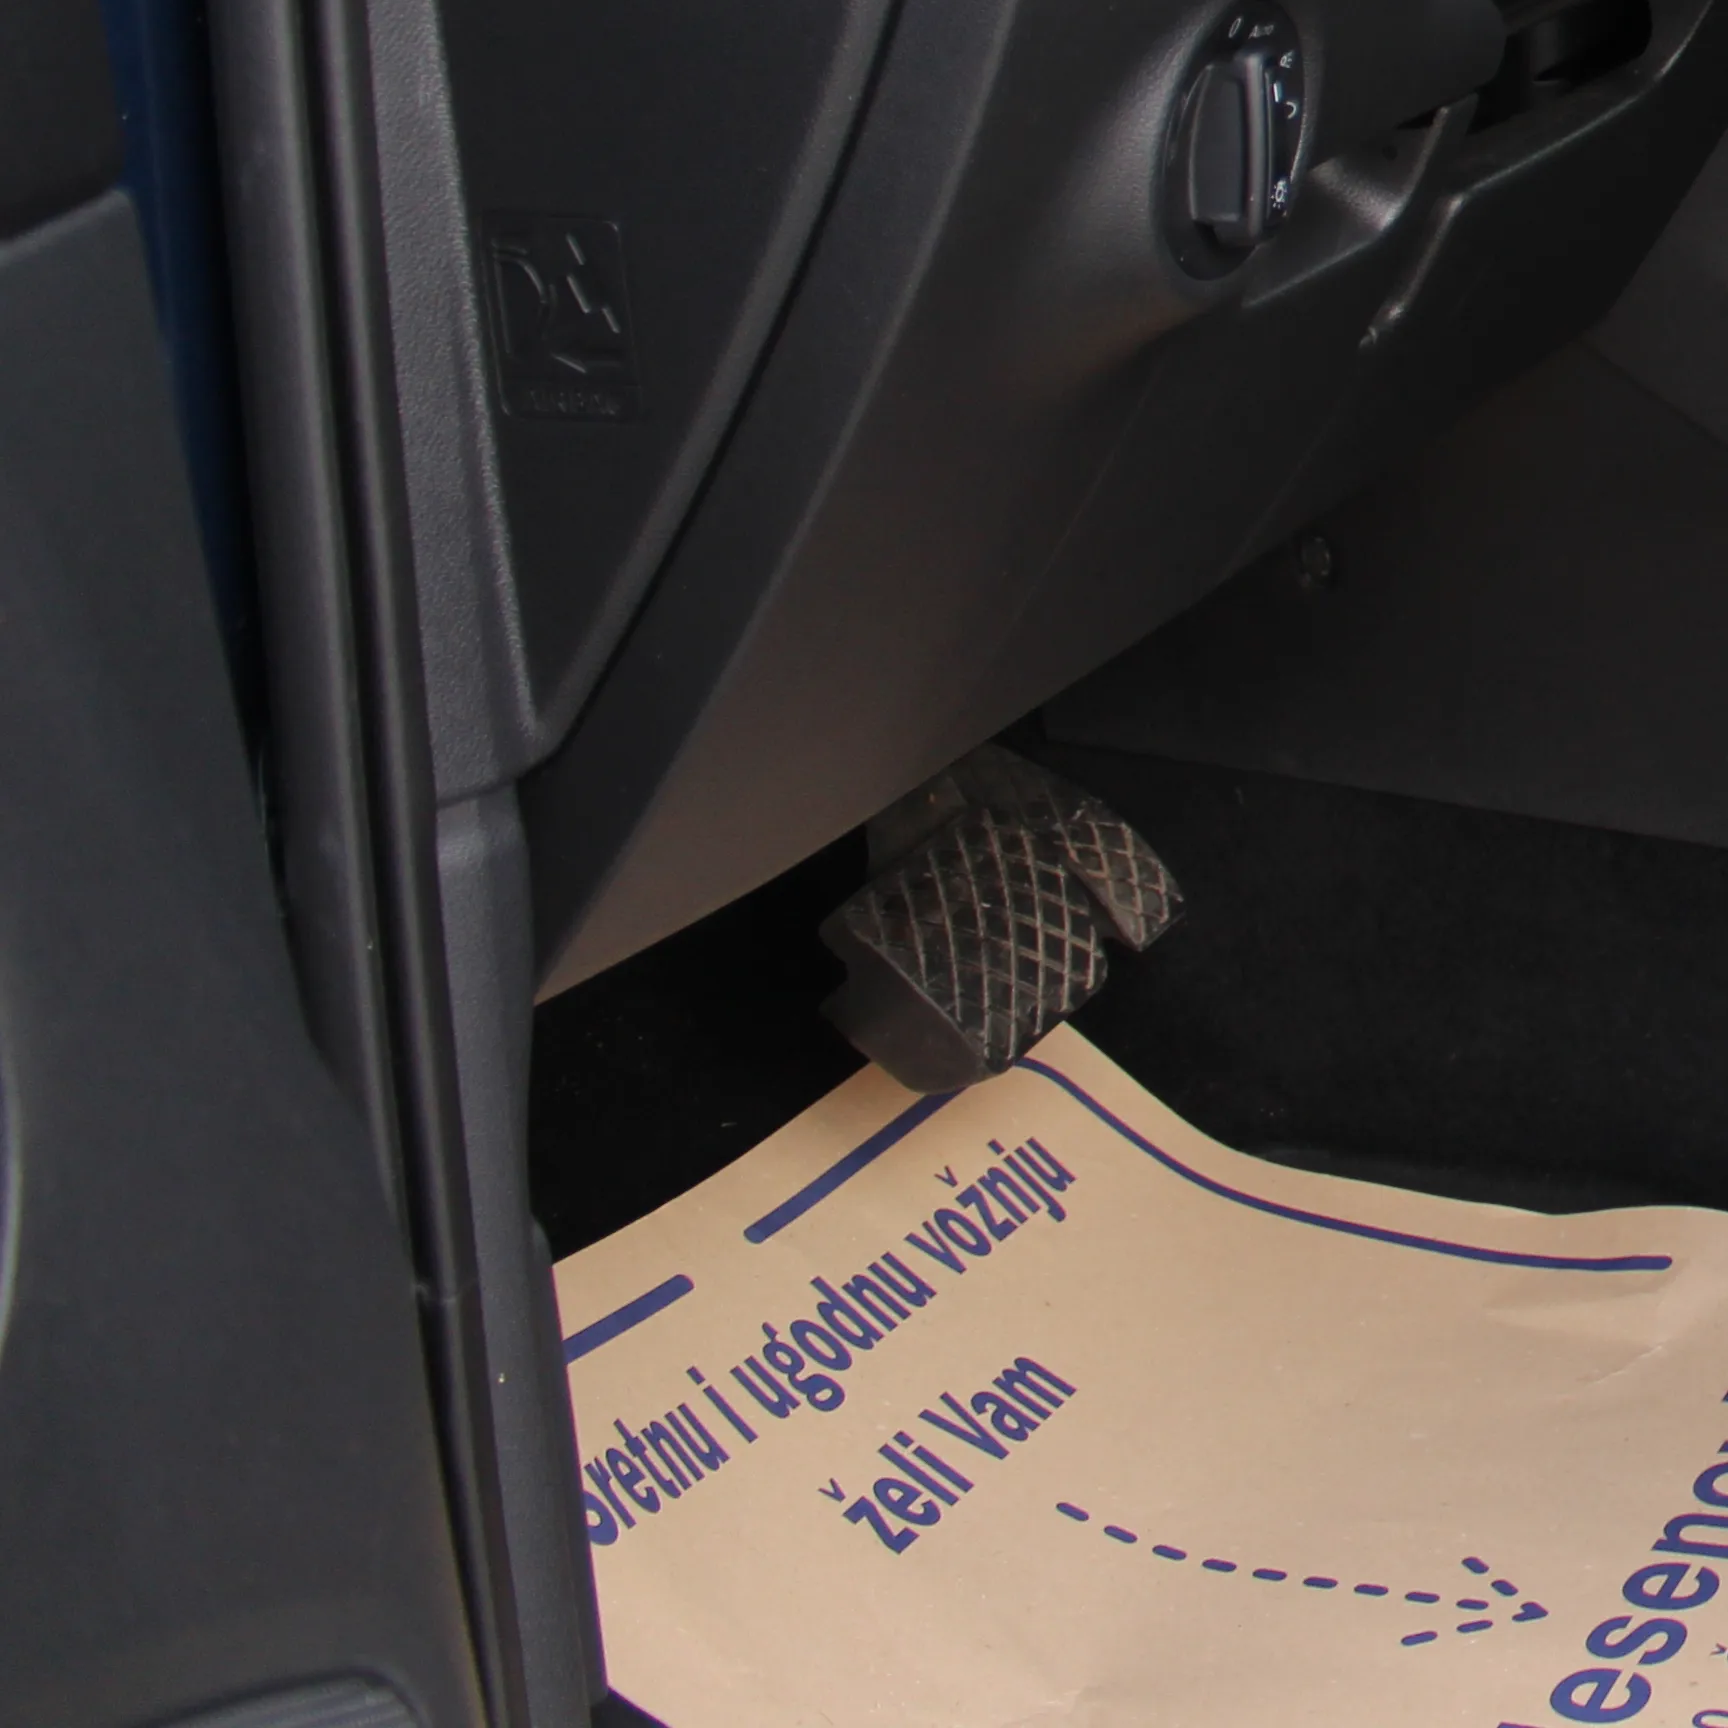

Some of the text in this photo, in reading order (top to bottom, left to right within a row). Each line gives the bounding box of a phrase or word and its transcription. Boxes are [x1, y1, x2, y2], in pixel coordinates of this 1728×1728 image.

[686, 1366, 759, 1444] i
[729, 1251, 938, 1418] ugodnu
[903, 1137, 1077, 1275] vožnju
[817, 1356, 1078, 1555] želi Vam
